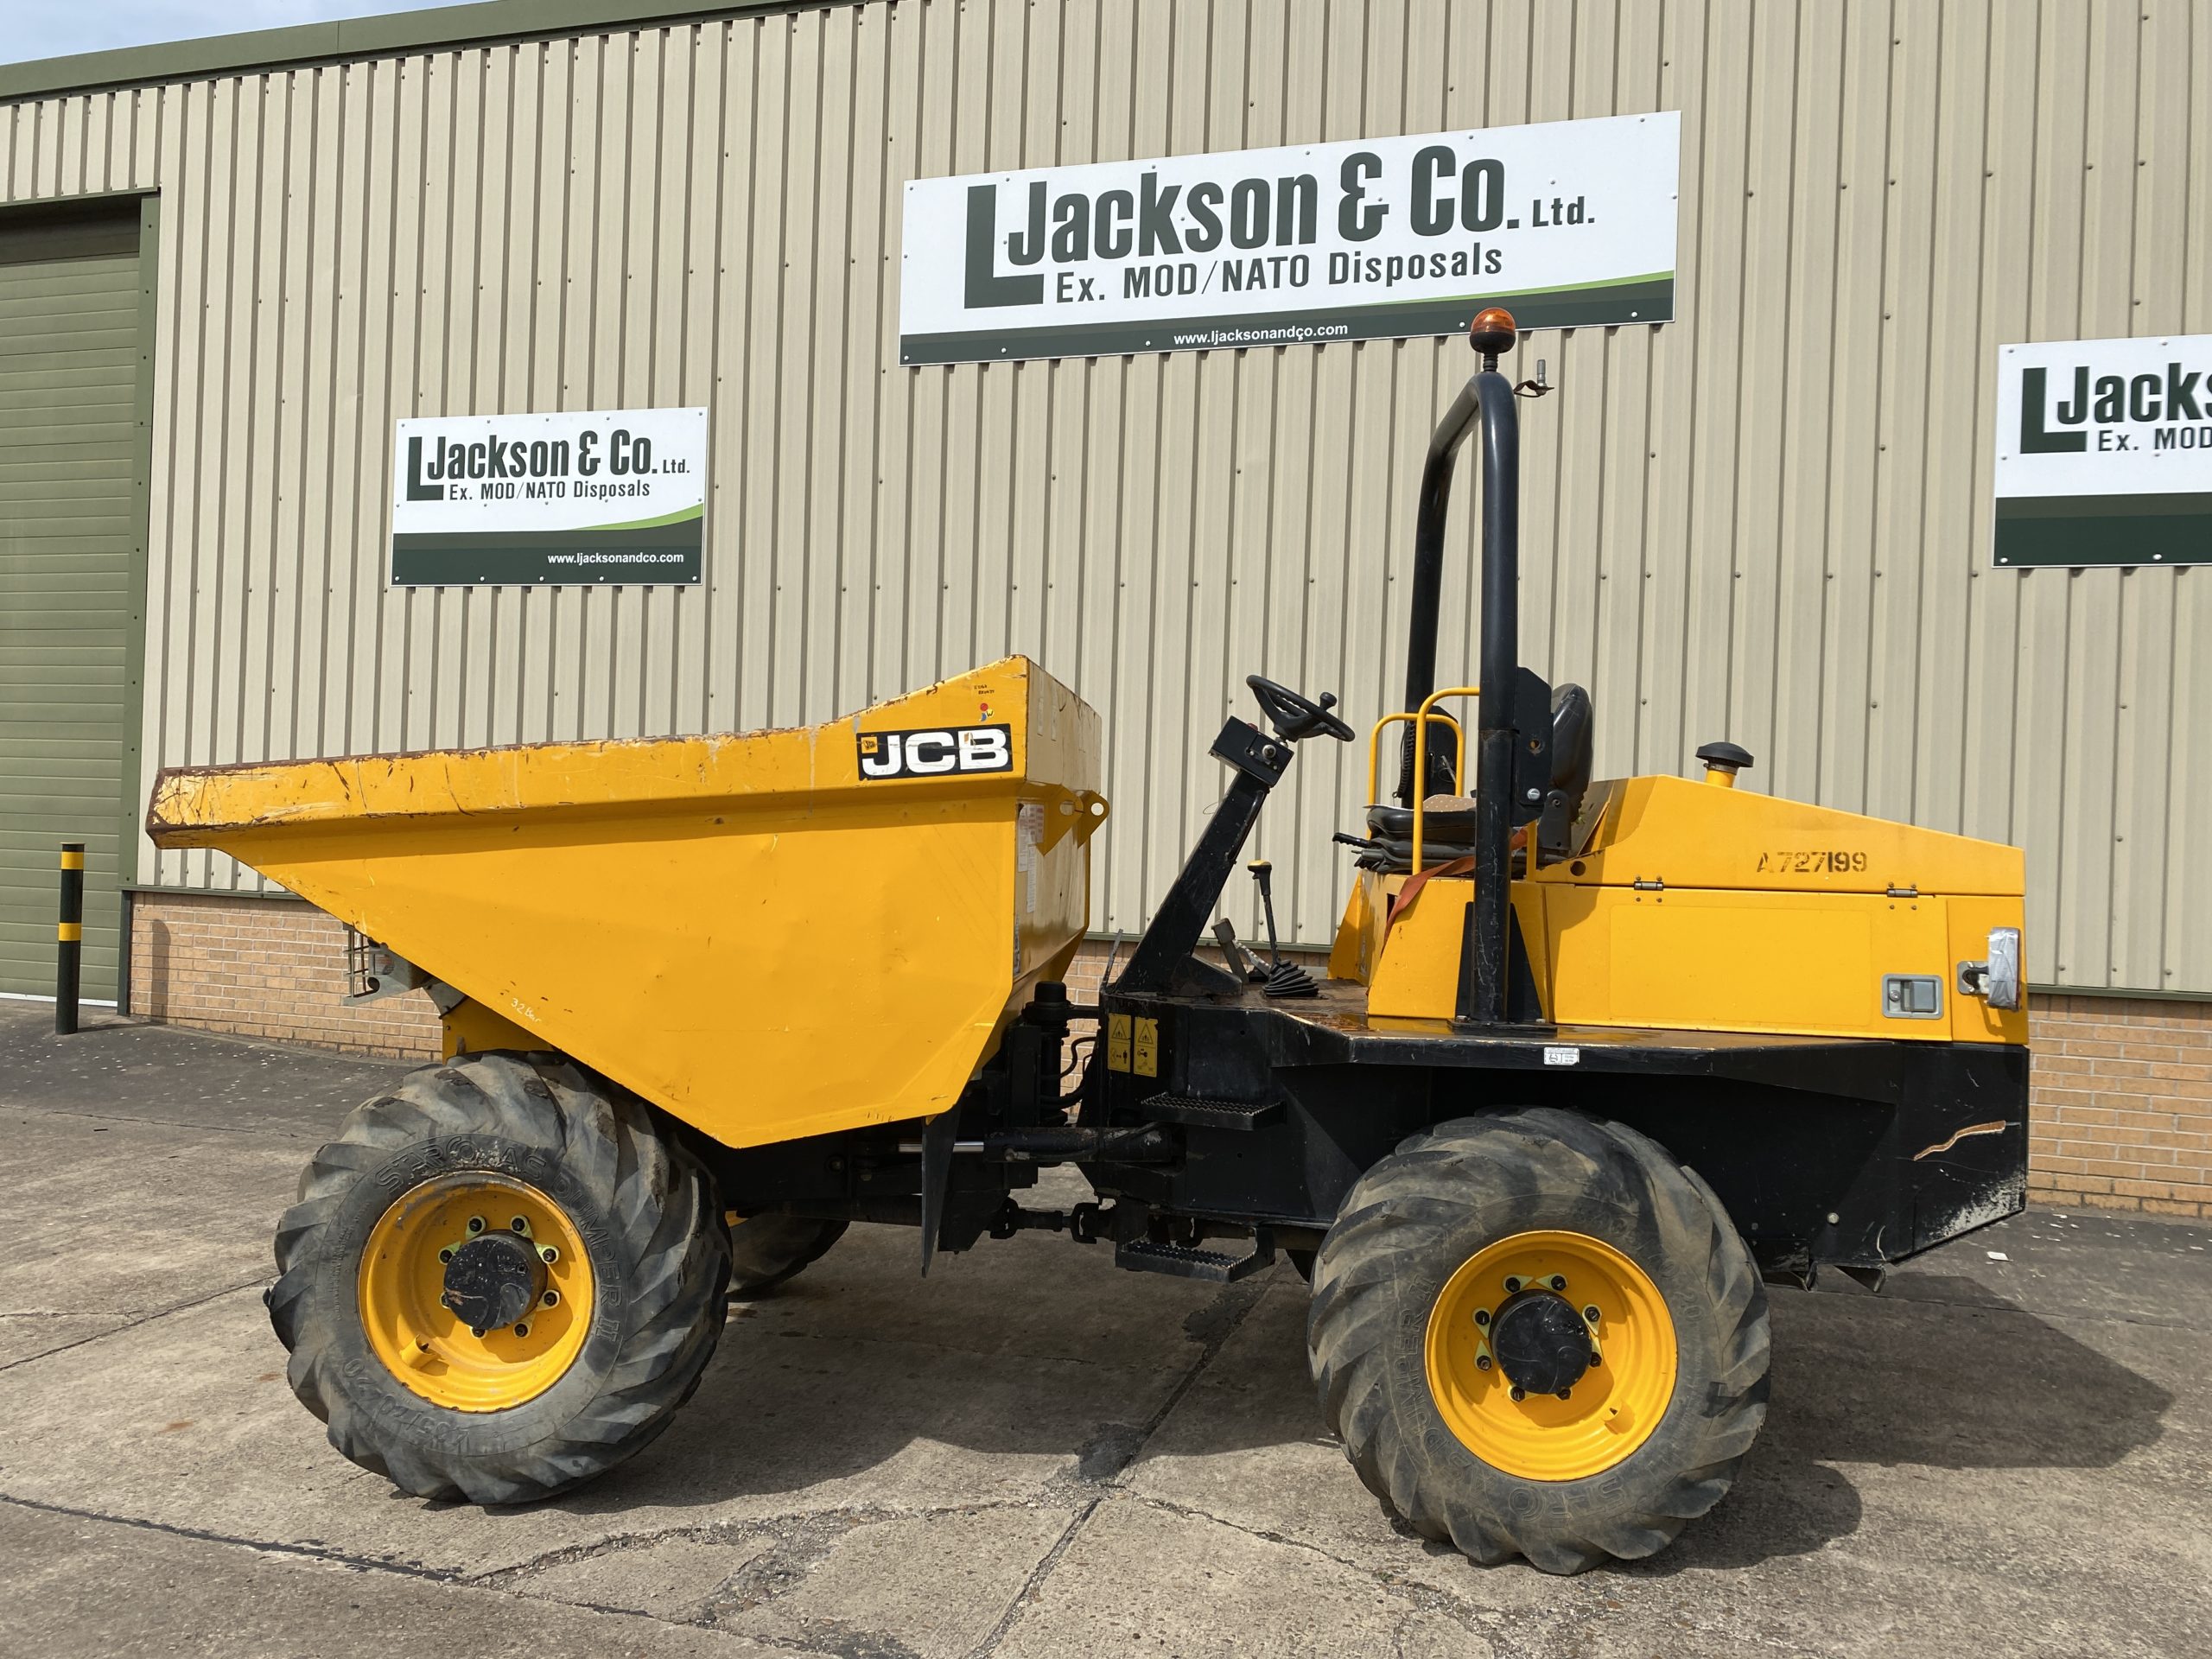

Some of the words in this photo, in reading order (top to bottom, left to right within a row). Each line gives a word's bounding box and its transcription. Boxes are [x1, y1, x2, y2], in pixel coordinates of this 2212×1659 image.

[1338, 151, 1390, 242] &
[1410, 145, 1520, 237] Co.
[1532, 195, 1596, 228] Ltd.
[1056, 271, 1105, 303] Ex.
[1123, 254, 1310, 299] MOD/NATO
[1328, 243, 1503, 288] Disposals
[577, 430, 601, 477] &
[609, 429, 658, 476] Co.
[663, 459, 690, 474] Ltd.
[2098, 429, 2139, 452] Ex.
[449, 484, 474, 500] Ex.
[480, 480, 566, 500] MOD/NATO
[573, 479, 651, 501] Disposals
[547, 551, 685, 566] www.ljacksonandco.com
[862, 728, 1009, 776] JCB
